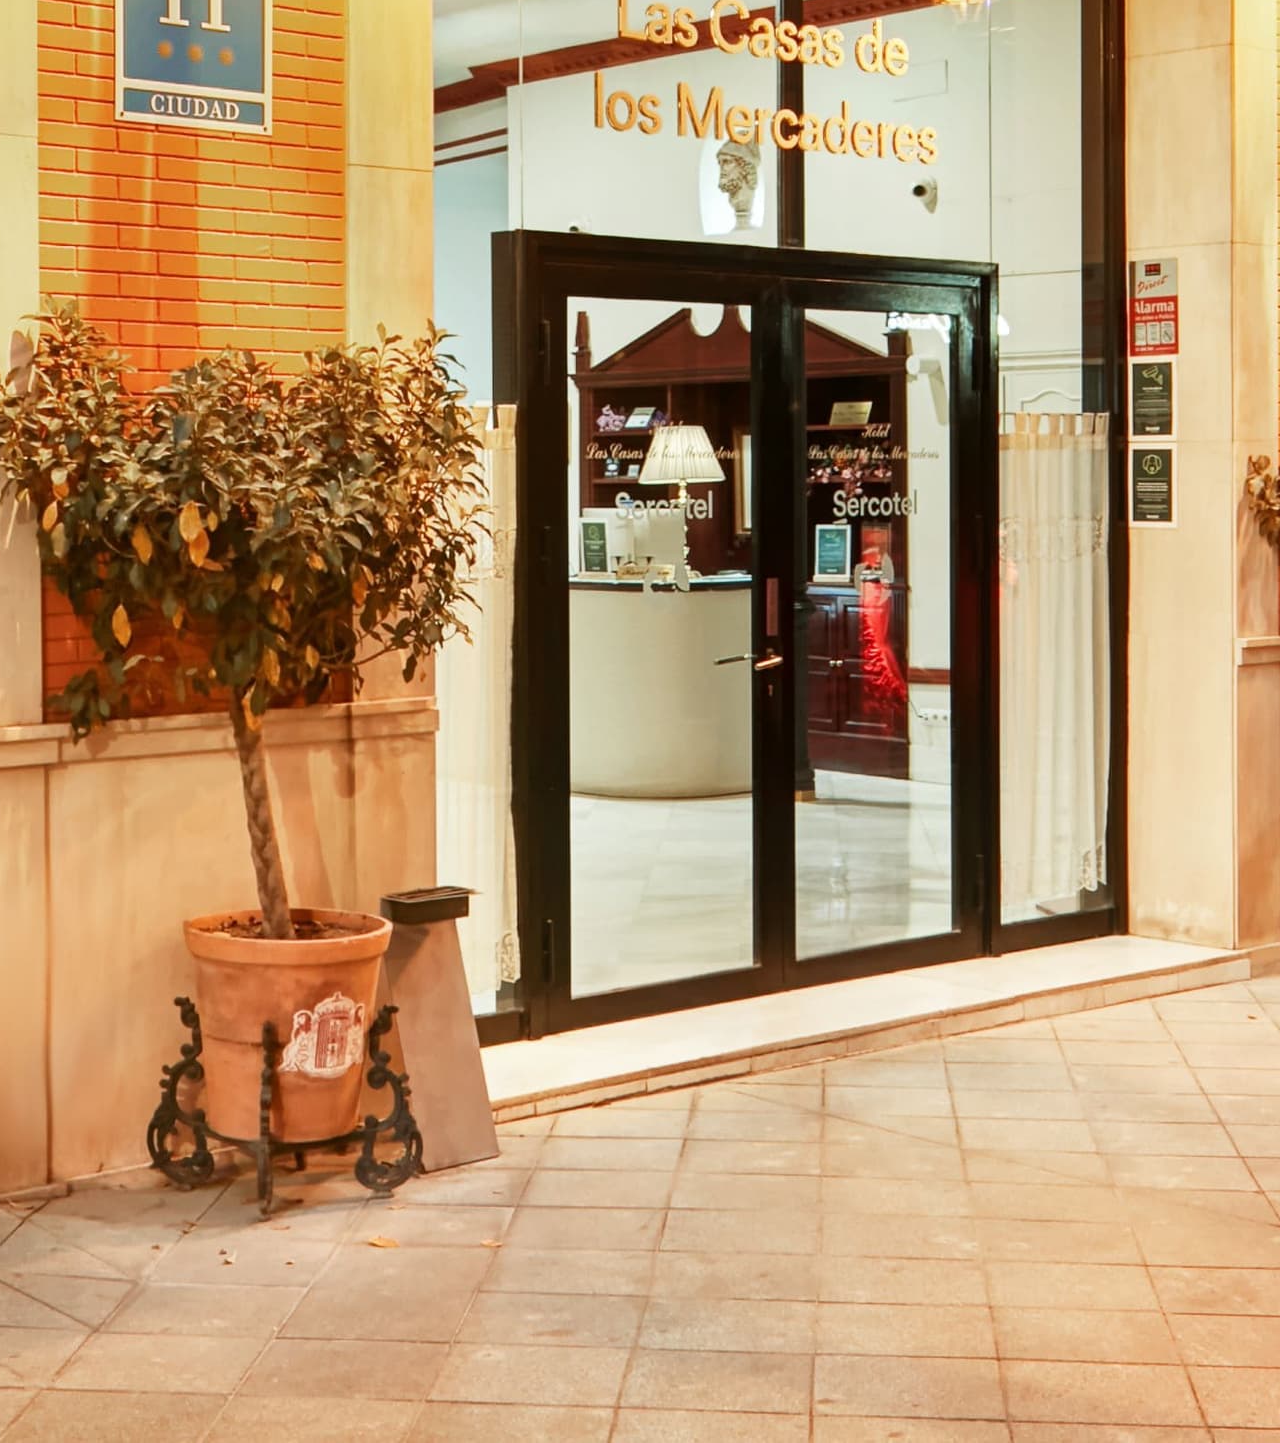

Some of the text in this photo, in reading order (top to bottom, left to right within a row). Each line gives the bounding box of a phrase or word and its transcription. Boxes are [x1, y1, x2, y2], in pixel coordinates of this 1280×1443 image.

[855, 20, 910, 77] de
[151, 94, 240, 120] CIUDAD
[594, 72, 939, 165] los Mercaderes
[832, 489, 918, 517] Sercotel
